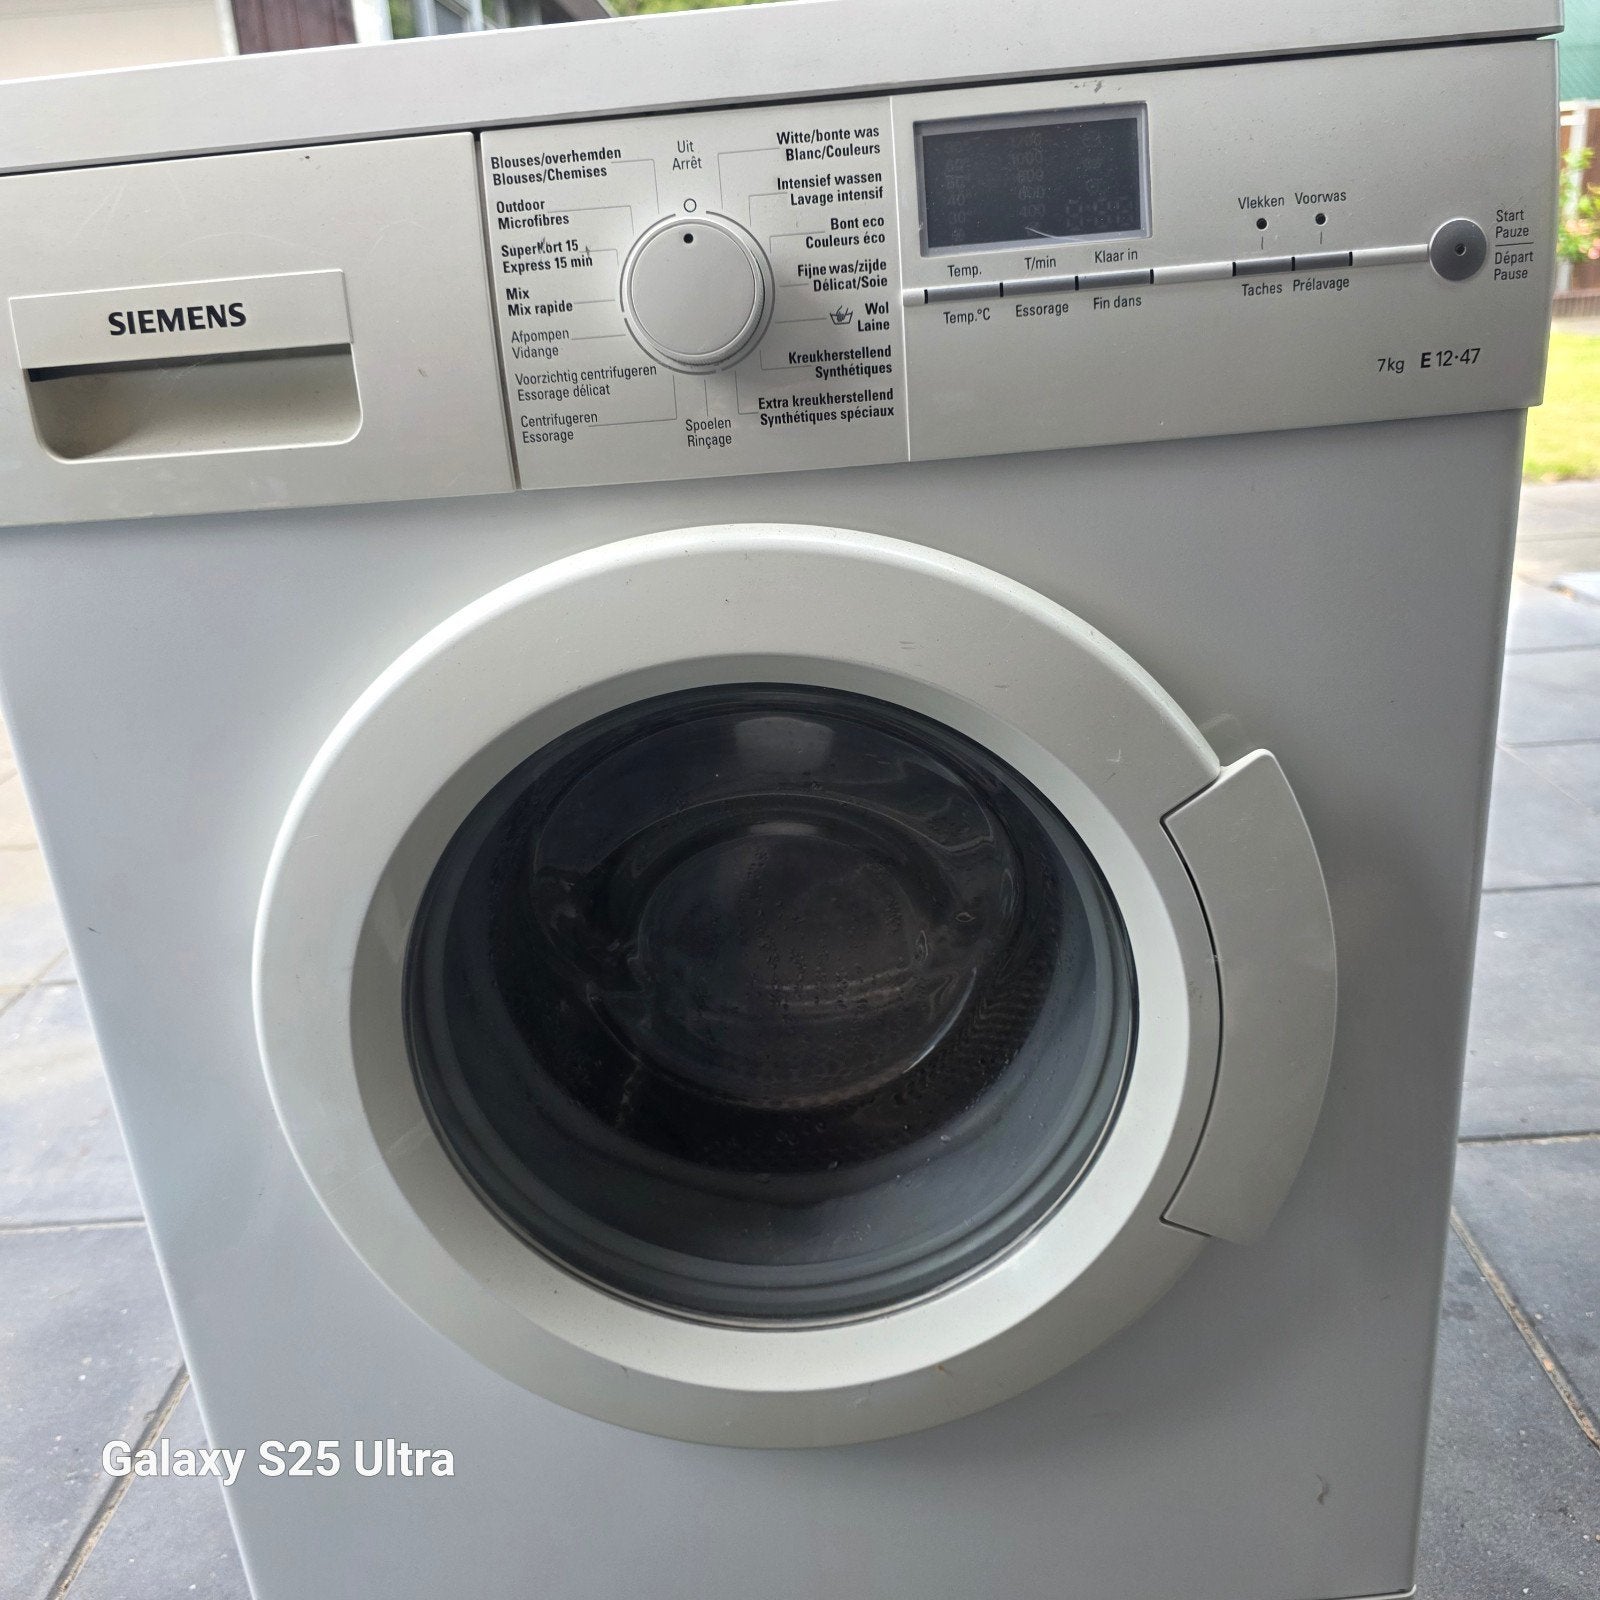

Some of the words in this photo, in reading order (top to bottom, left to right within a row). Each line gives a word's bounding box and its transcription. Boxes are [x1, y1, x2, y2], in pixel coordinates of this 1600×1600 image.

[777, 128, 850, 145] Witte/bonte
[854, 127, 879, 138] was
[677, 140, 694, 152] Uit
[786, 143, 880, 161] Blanc/Couleurs
[491, 147, 622, 169] Blouses/overhemden
[672, 157, 702, 170] Arrêt
[493, 166, 608, 186] Blouses/Chemises
[777, 174, 831, 190] Intensief
[835, 172, 882, 185] wassen
[791, 192, 833, 206] Lavage
[837, 187, 884, 202] intensif
[1238, 195, 1285, 210] Vlekken
[1294, 191, 1347, 205] Voorwas
[497, 199, 545, 213] Outdoor
[498, 214, 569, 230] Microfibres
[1496, 209, 1524, 222] Start
[831, 217, 859, 230] Bont
[863, 217, 885, 227] eco
[1495, 225, 1529, 239] Pauze
[566, 240, 579, 251] 15
[806, 234, 860, 249] Couleurs
[864, 233, 885, 244] éco
[1024, 256, 1056, 271] T/min
[1095, 250, 1124, 263] Klaar
[1127, 249, 1138, 260] in
[1495, 251, 1534, 265] Départ
[503, 259, 551, 275] Express
[555, 258, 567, 269] 15
[571, 255, 593, 267] min
[797, 264, 827, 279] Fijne
[829, 259, 887, 274] was/zijde
[948, 265, 982, 278] Temp.
[1494, 268, 1528, 280] Pause
[813, 276, 888, 293] Délicat/Soie
[1242, 282, 1283, 296] Taches
[1293, 277, 1350, 292] Prélavage
[506, 288, 530, 300] Mix
[508, 304, 531, 316] Mix
[535, 300, 573, 316] rapide
[865, 302, 889, 315] Wol
[1015, 302, 1069, 317] Essorage
[1093, 297, 1111, 310] Fin
[1114, 295, 1142, 307] dans
[108, 303, 246, 336] SIEMENS
[858, 320, 890, 332] Laine
[511, 329, 569, 345] Afpompen
[512, 346, 559, 359] Vidange
[789, 346, 892, 364] Kreukherstellend
[815, 364, 892, 380] Synthétiques
[1377, 358, 1405, 373] 7kg
[515, 370, 578, 386] Voorzichtig
[581, 365, 657, 380] centrifugeren
[518, 387, 570, 401] Essorage
[573, 384, 610, 397] délicat
[758, 397, 789, 410] Extra
[792, 389, 894, 407] kreukherstellend
[521, 413, 598, 428] Centrifugeren
[760, 410, 837, 427] Synthétiques
[840, 405, 894, 422] spéciaux
[686, 418, 732, 433] Spoelen
[522, 431, 574, 444] Essorage
[687, 434, 732, 449] Rinçage
